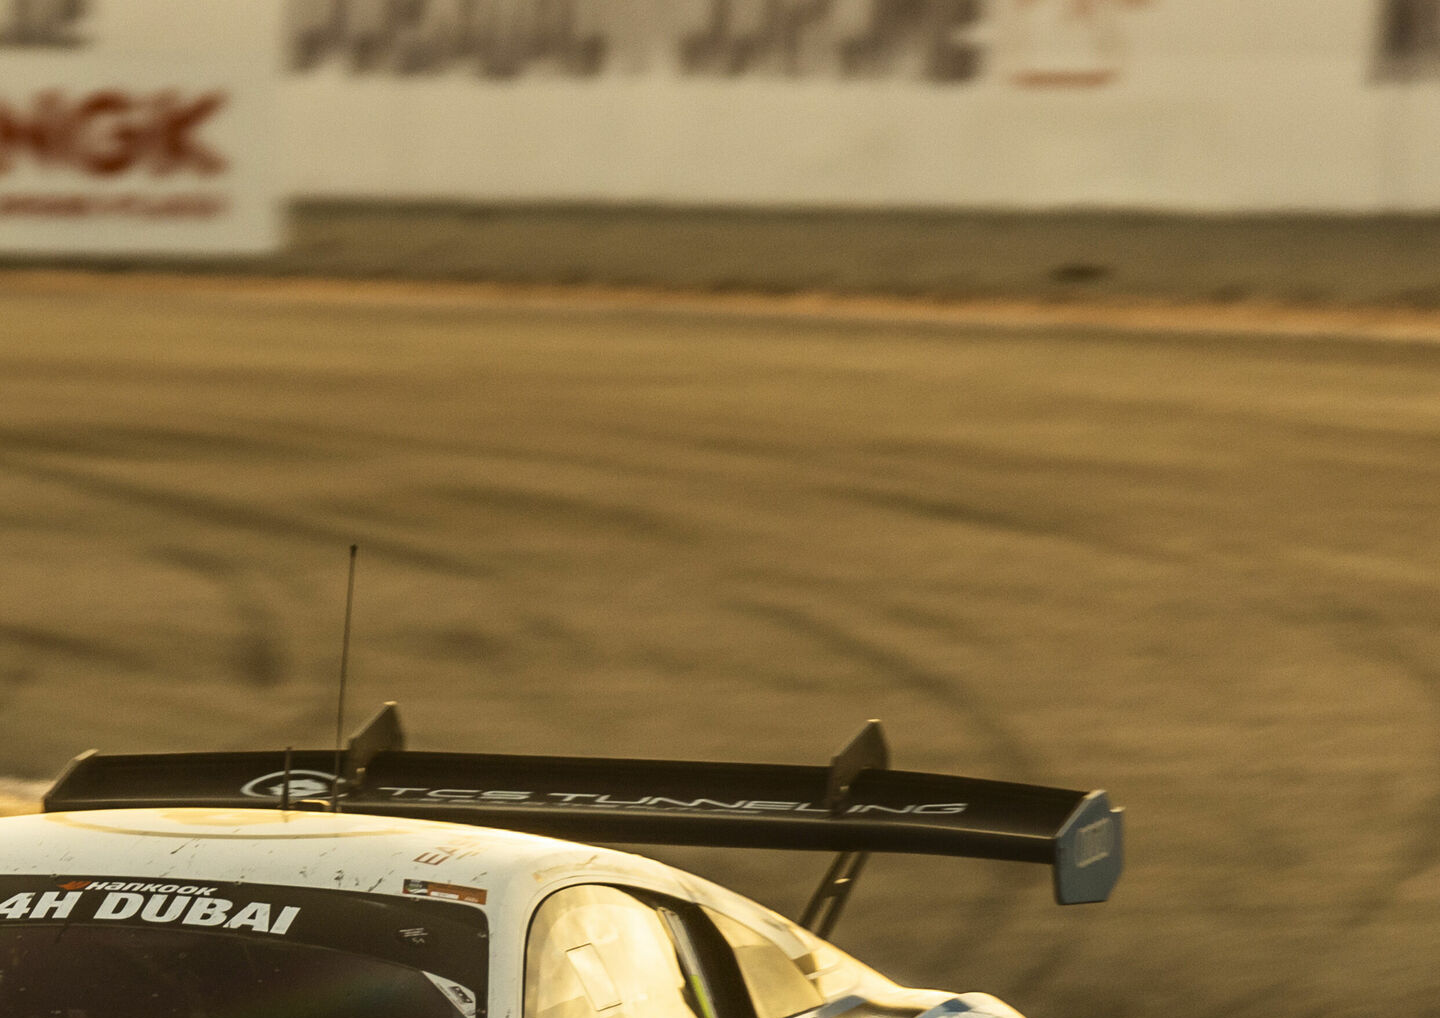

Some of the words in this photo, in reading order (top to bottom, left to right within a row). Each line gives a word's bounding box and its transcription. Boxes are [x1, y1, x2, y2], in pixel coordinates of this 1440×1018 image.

[376, 786, 531, 802] TCS
[548, 791, 968, 815] TUNNELING
[92, 892, 302, 935] DUBAI
